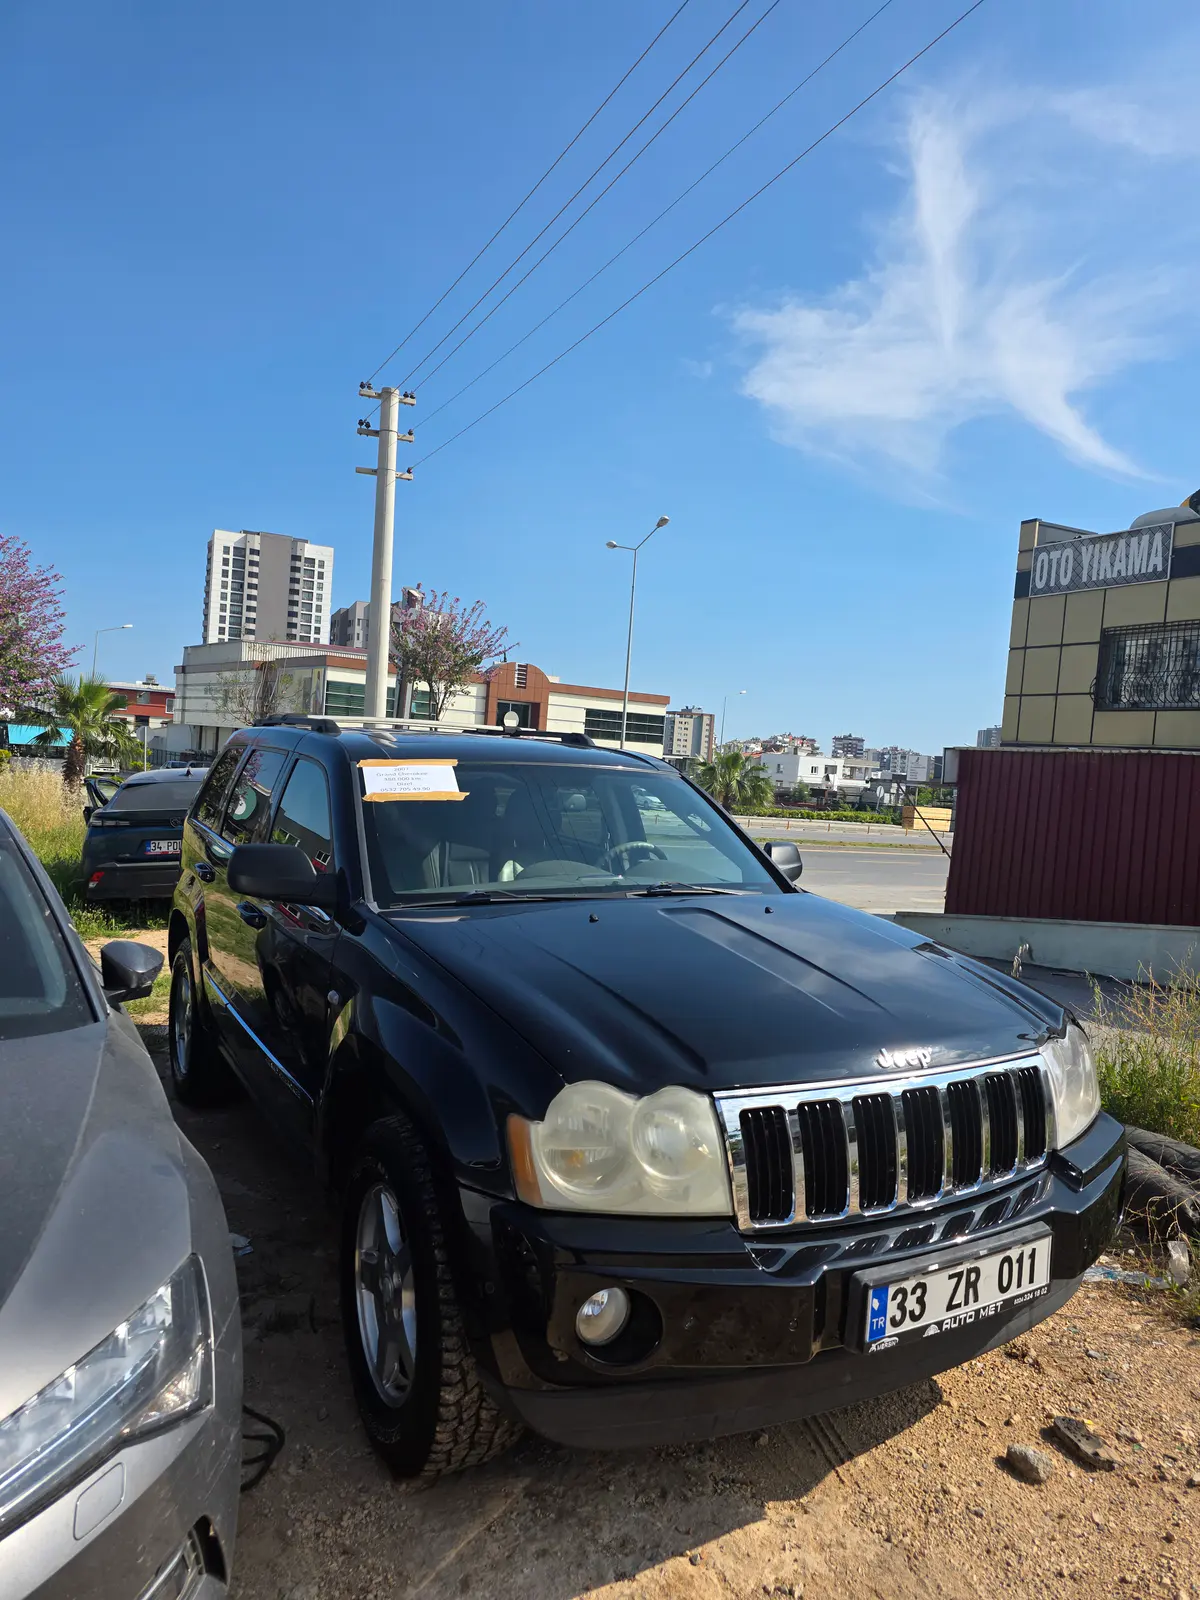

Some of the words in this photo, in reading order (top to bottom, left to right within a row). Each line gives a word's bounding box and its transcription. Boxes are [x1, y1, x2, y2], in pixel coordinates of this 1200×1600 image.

[1035, 548, 1073, 589] OTO
[1081, 532, 1163, 583] YIKAMA
[151, 841, 162, 851] 34
[876, 1047, 932, 1069] Jeep
[872, 1316, 885, 1330] TR
[889, 1281, 928, 1329] 33
[945, 1265, 981, 1313] ZR
[997, 1247, 1037, 1294] 011
[942, 1311, 975, 1332] AUTO
[979, 1301, 1003, 1319] MET
